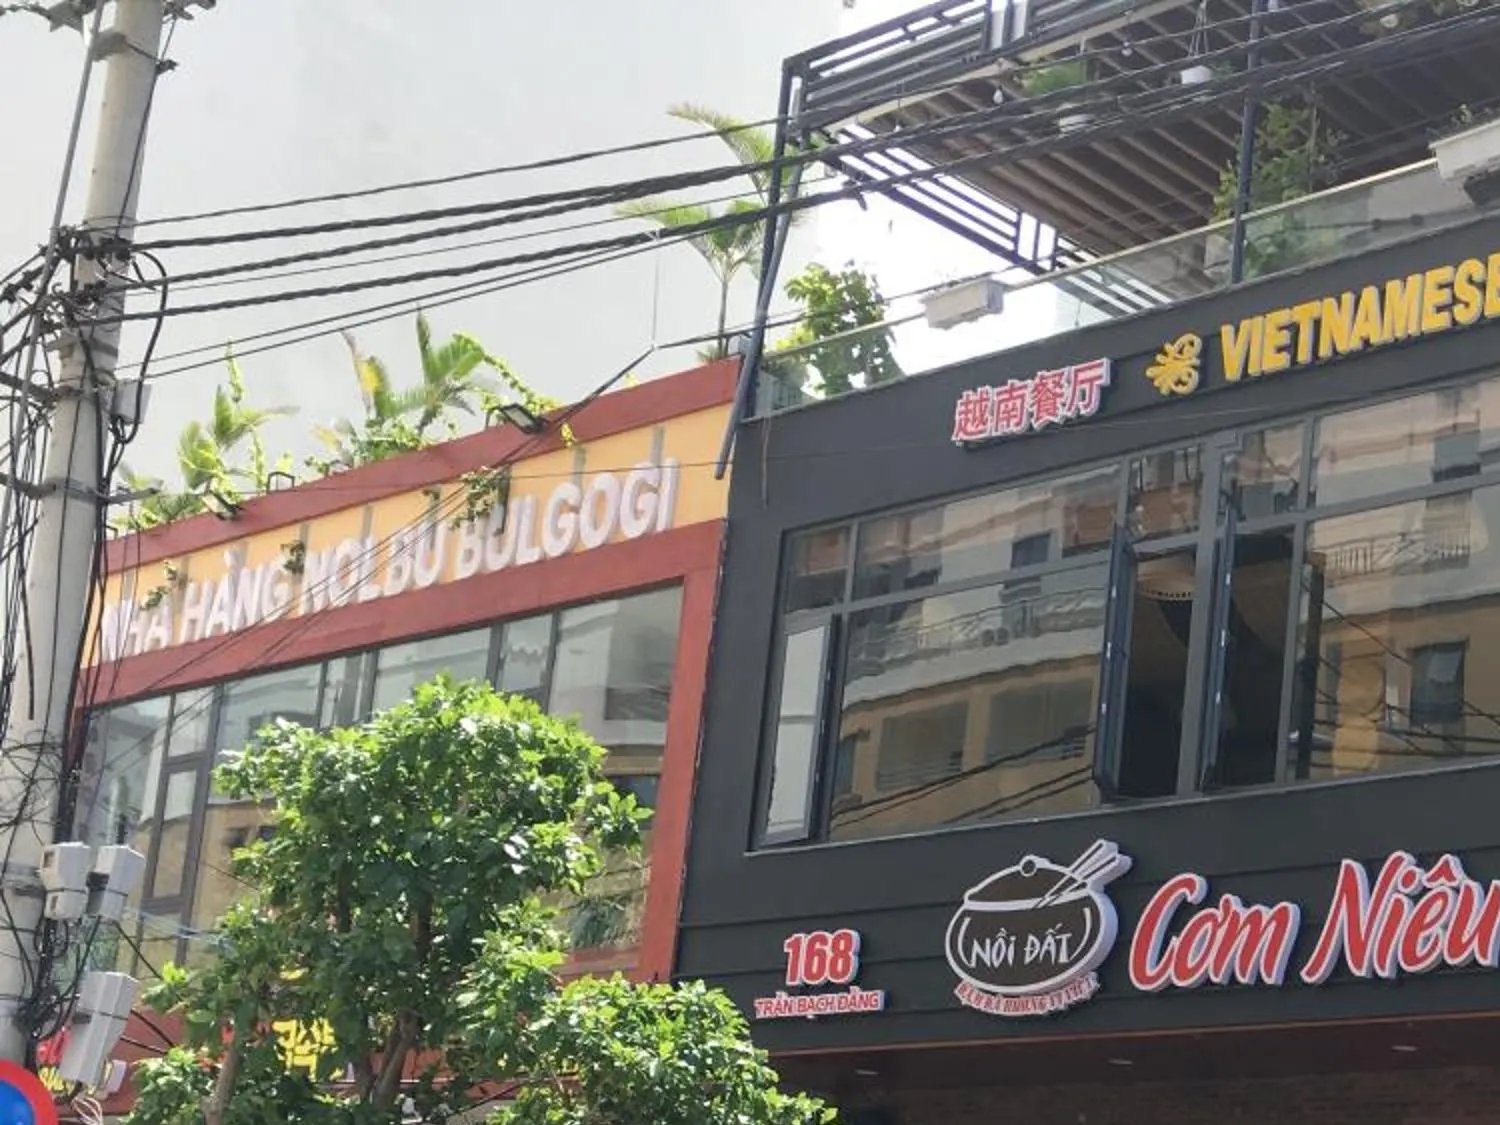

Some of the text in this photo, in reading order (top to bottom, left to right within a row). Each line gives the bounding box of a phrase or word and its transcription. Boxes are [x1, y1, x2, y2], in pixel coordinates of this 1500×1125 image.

[952, 357, 1111, 446] 越南餐厅
[180, 548, 295, 642] HÀNG
[455, 457, 680, 580] BULGOGI
[784, 929, 860, 986] 168
[970, 923, 1073, 968] NỒI ĐẤT
[1130, 873, 1301, 991] Cơm
